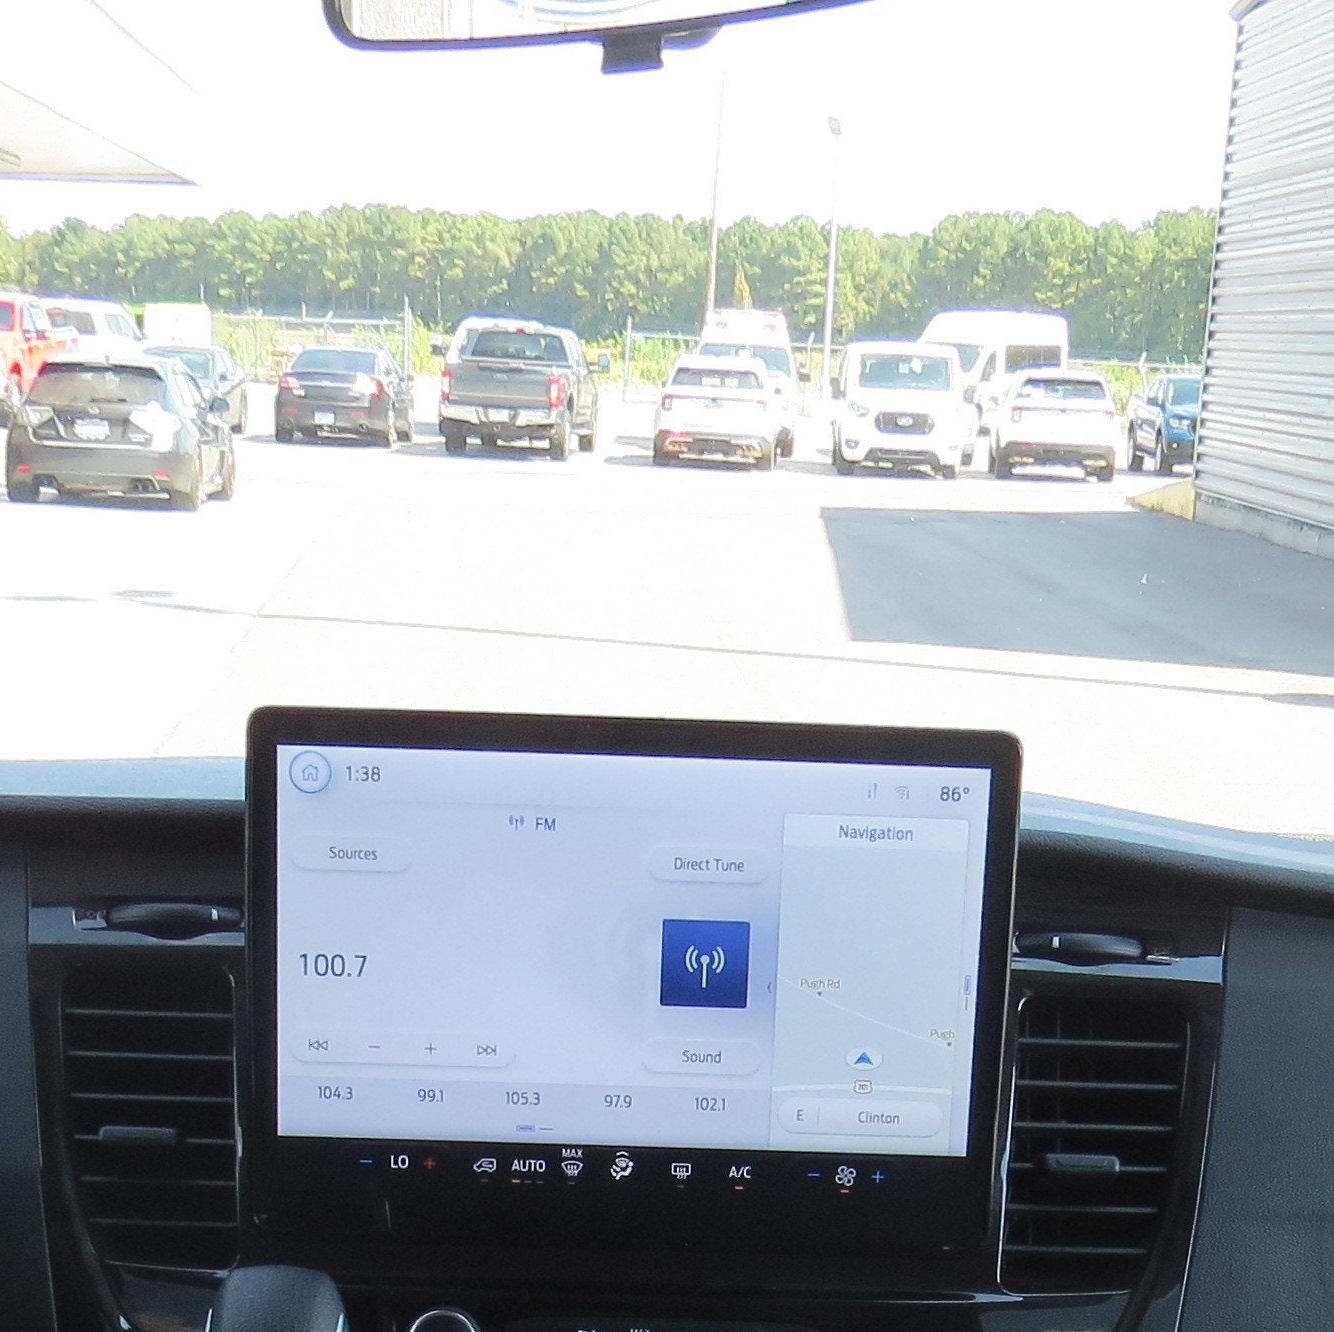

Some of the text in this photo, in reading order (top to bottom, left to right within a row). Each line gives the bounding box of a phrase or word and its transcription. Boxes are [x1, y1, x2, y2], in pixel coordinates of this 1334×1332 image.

[345, 766, 381, 782] 1:38
[535, 817, 556, 832] FM
[838, 824, 914, 843] Navigation
[329, 845, 378, 861] Sources
[674, 857, 745, 873] Direct Tune
[299, 953, 368, 978] 100.7
[682, 1050, 722, 1065] Sound
[317, 1085, 353, 1100] 104.3
[417, 1088, 444, 1103] 99.1
[505, 1091, 541, 1106] 105.3
[604, 1094, 632, 1109] 97.9
[695, 1097, 727, 1112] 102.1
[796, 1110, 901, 1125] E Clinton
[562, 1149, 583, 1158] MAX
[390, 1155, 409, 1169] LO
[511, 1159, 546, 1173] AUTO
[728, 1166, 751, 1179] A/C
